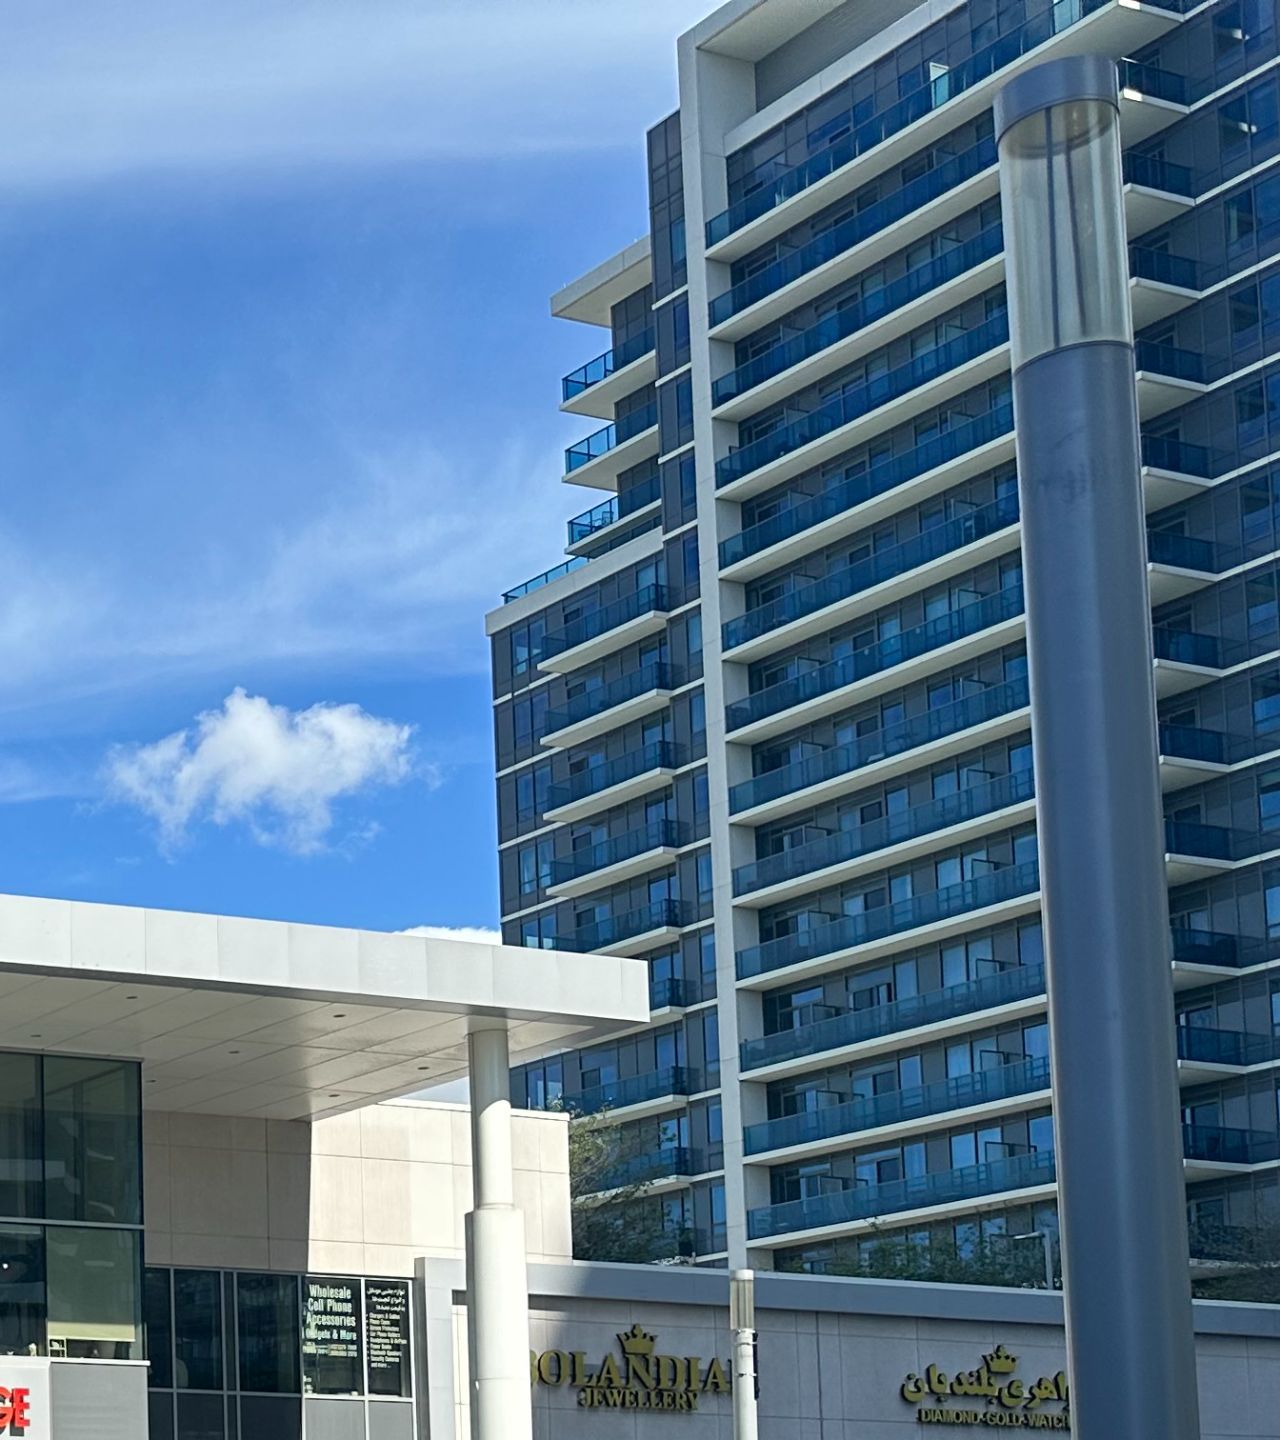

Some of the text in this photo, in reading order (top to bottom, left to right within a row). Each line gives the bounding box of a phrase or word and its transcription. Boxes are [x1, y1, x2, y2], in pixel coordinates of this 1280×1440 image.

[309, 1284, 351, 1299] Wholesale
[308, 1298, 352, 1312] Cell Phone
[306, 1311, 356, 1327] Accessories
[577, 1387, 699, 1411] JEWELLERY
